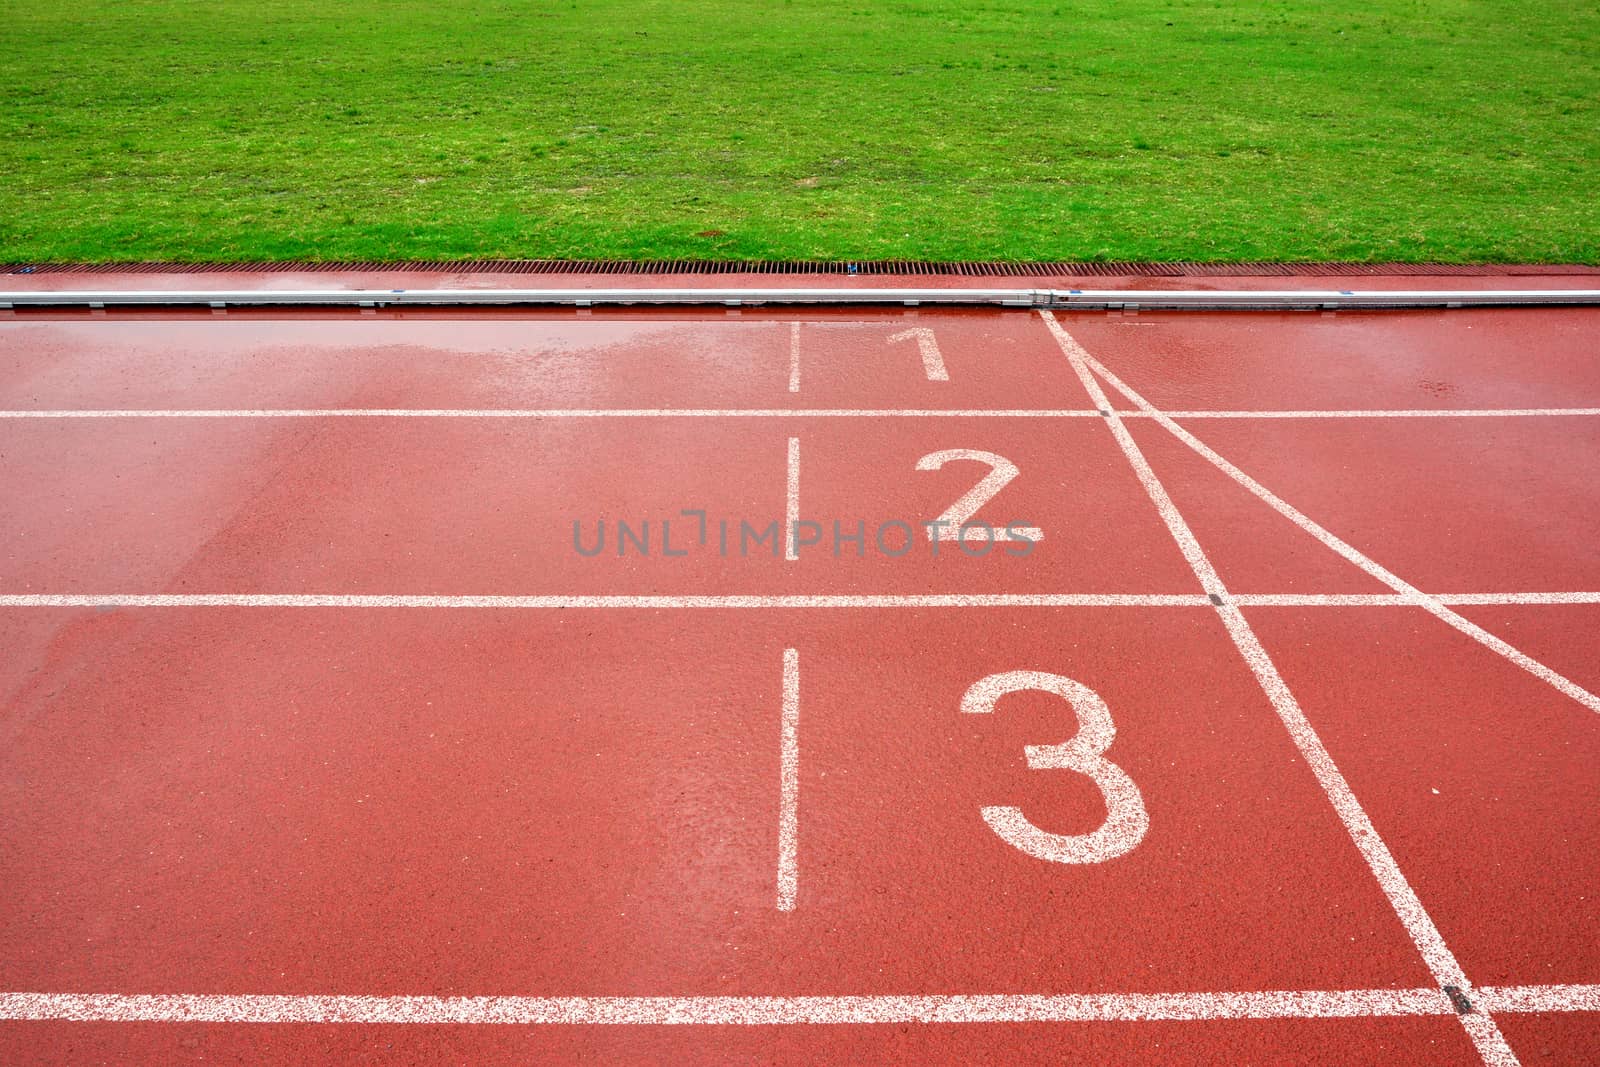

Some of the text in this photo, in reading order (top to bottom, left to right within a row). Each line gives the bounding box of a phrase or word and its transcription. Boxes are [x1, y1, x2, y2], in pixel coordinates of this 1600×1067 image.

[886, 327, 949, 381] 1
[915, 449, 1044, 541] 2
[960, 670, 1150, 864] 3
